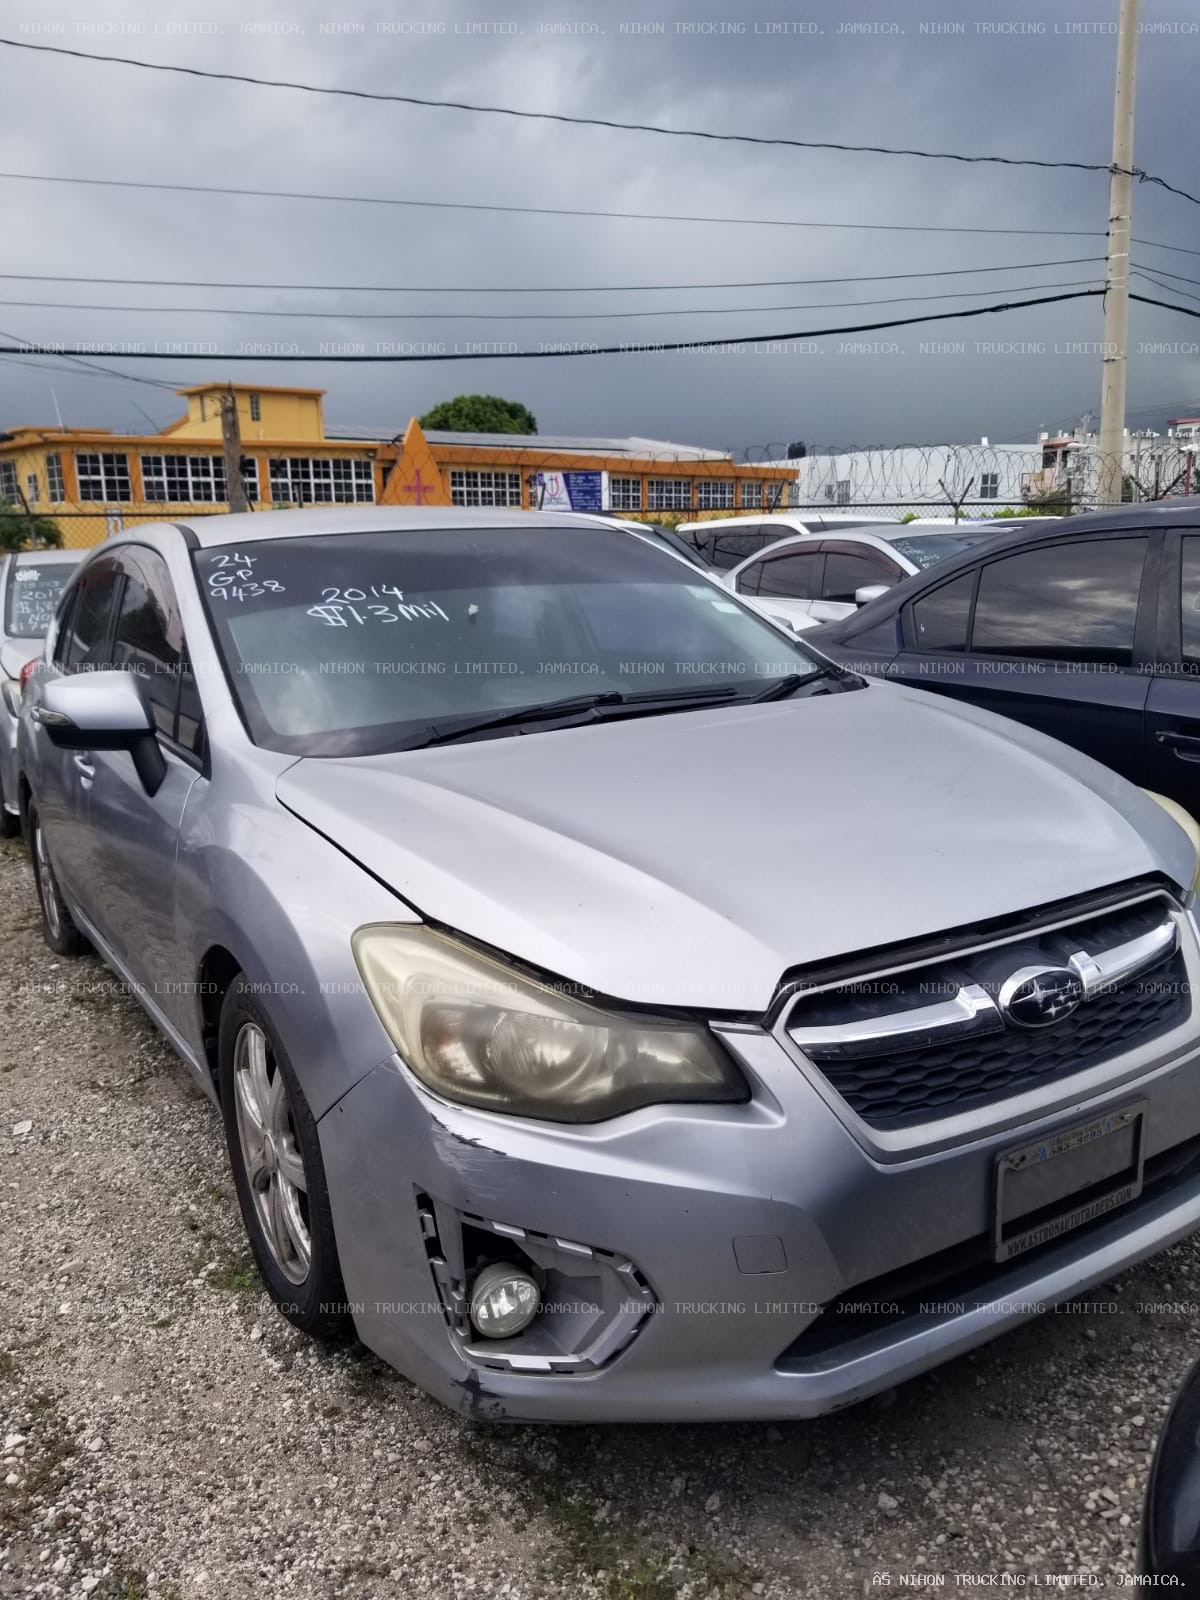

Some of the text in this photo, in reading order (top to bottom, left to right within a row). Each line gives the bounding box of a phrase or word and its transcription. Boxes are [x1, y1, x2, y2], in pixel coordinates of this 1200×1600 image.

[211, 553, 257, 568] 24
[210, 580, 286, 602] 9438
[321, 584, 404, 604] 2014
